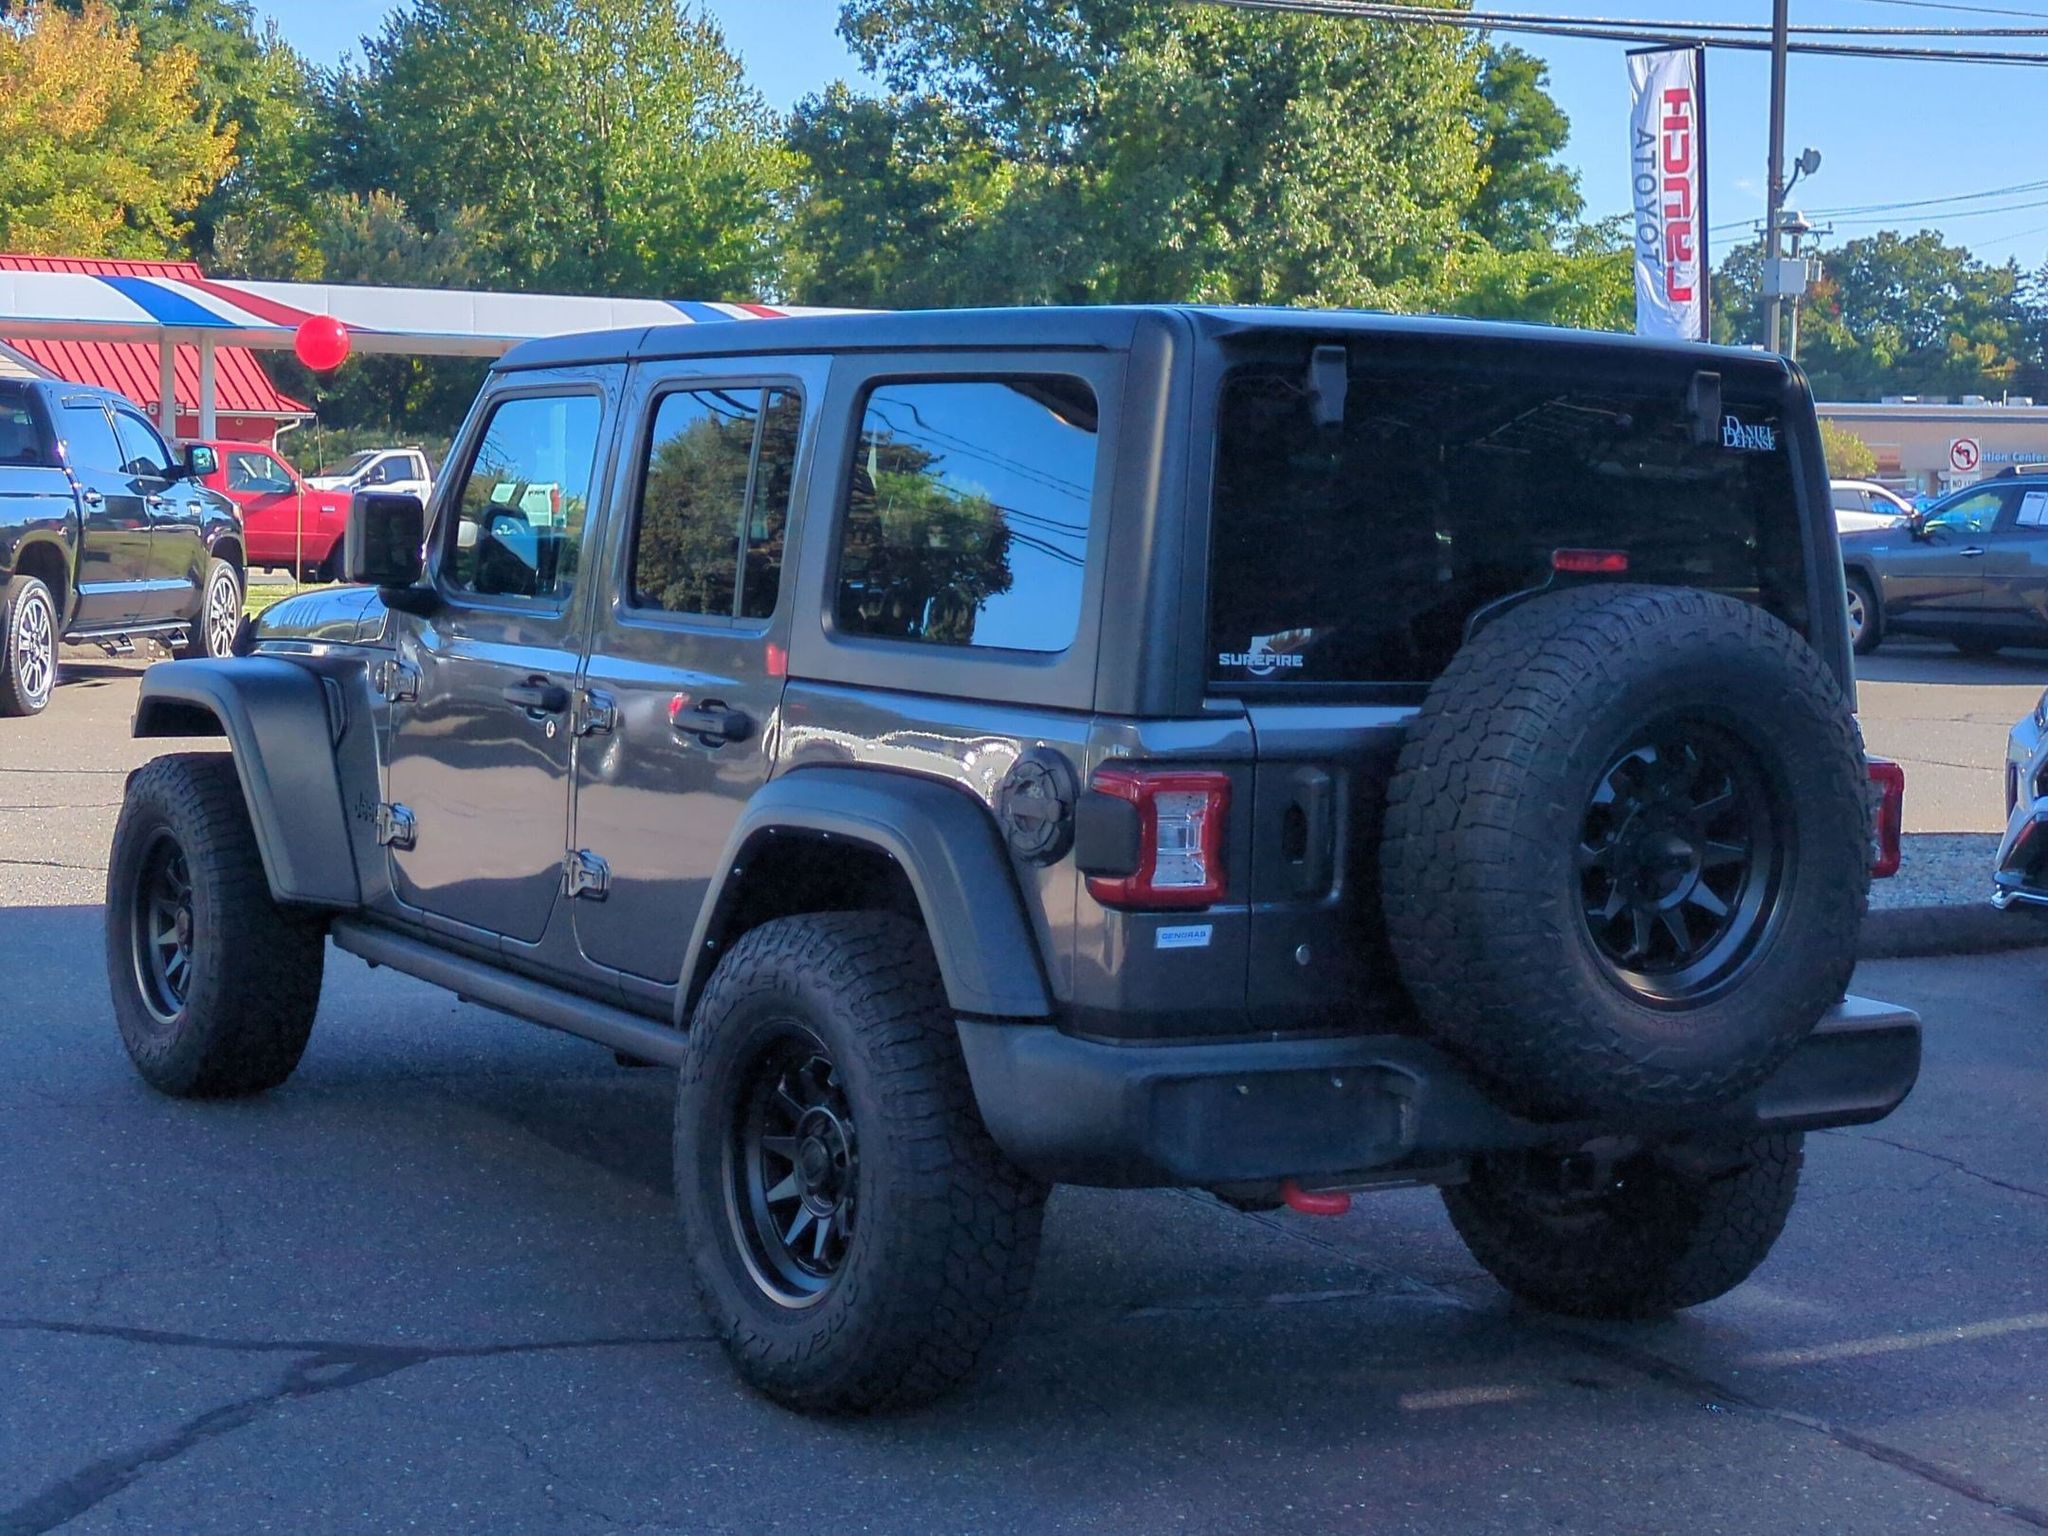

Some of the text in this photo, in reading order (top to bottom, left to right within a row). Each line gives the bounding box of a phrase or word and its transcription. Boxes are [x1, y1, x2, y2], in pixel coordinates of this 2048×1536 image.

[147, 402, 185, 417] 65
[1725, 415, 1774, 440] DANIEL
[1722, 427, 1776, 451] DEFENSE
[1219, 653, 1303, 667] SUREFIRE
